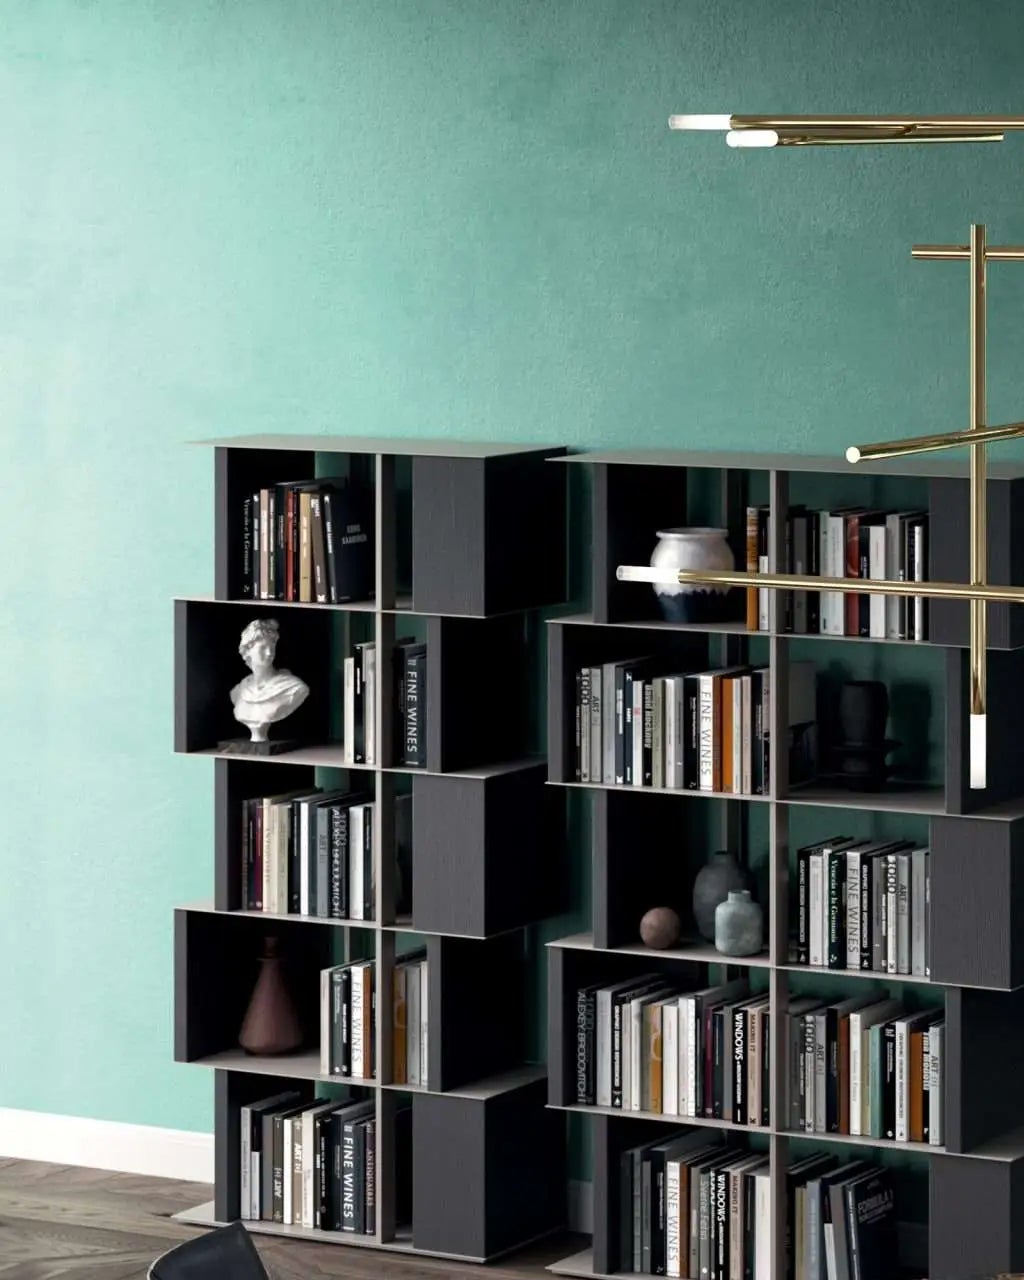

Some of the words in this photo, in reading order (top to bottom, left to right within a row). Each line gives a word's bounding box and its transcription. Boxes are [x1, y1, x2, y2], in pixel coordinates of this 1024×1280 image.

[408, 671, 418, 702] FINE
[702, 691, 712, 723] FINE
[408, 707, 418, 752] WINES
[702, 729, 712, 776] WINES
[848, 868, 858, 900] FINE
[848, 905, 858, 952] WINES
[352, 982, 362, 1010] FINE
[352, 1018, 362, 1062] WINES
[734, 1013, 744, 1060] WINDOWS
[344, 1137, 354, 1168] FINE
[344, 1174, 354, 1218] WINES
[668, 1178, 678, 1209] FINE
[717, 1174, 726, 1222] WINDOWS
[668, 1214, 678, 1262] WINES
